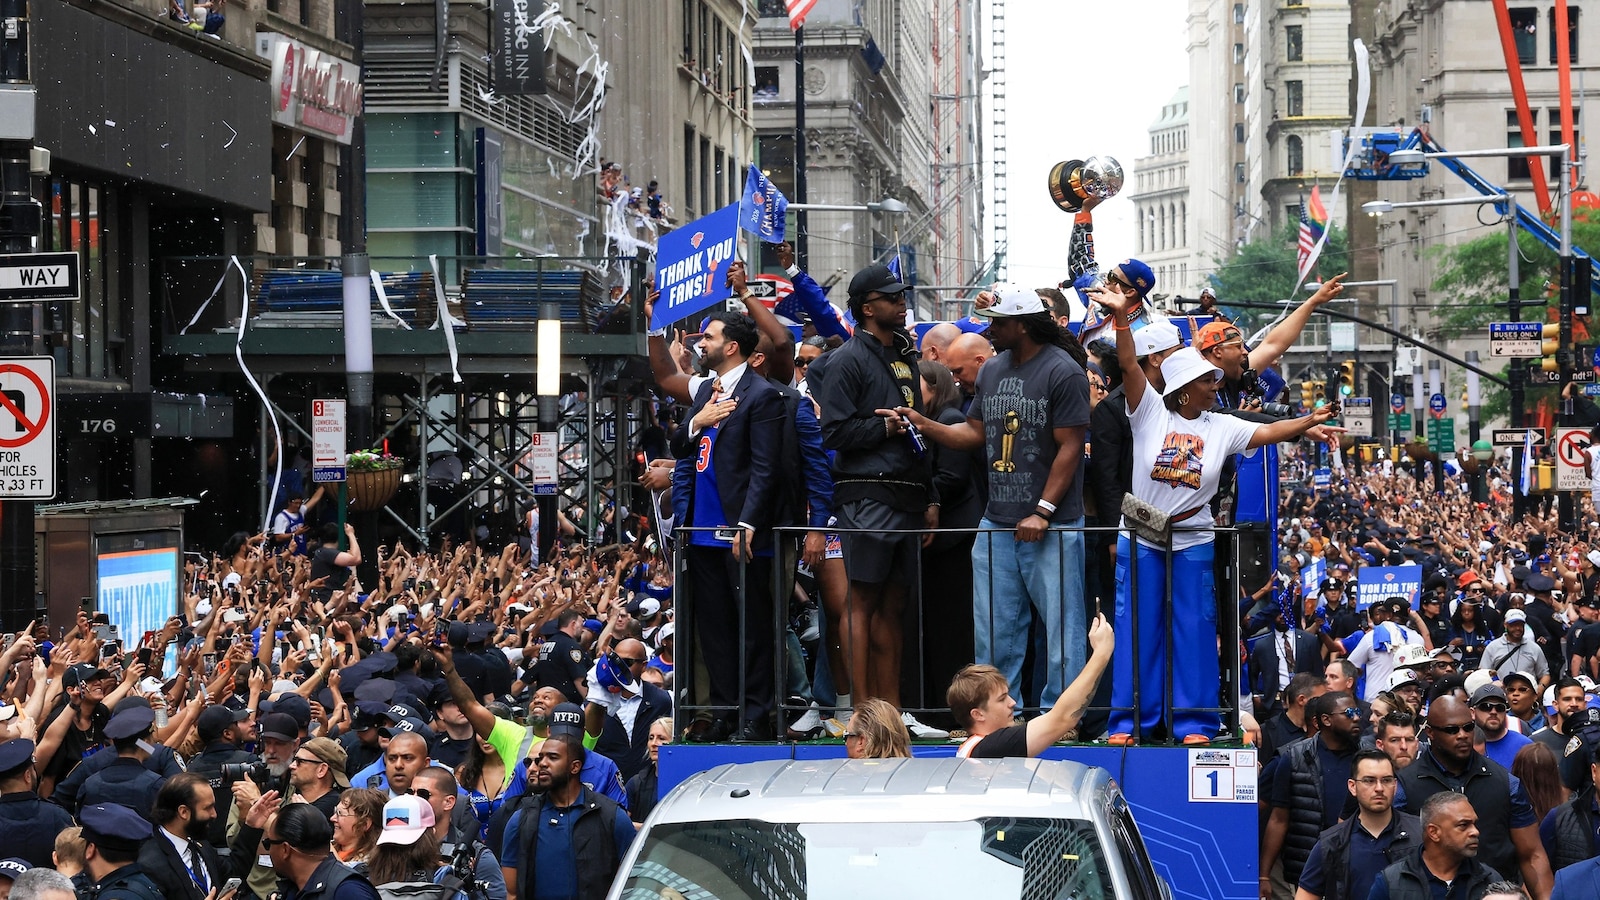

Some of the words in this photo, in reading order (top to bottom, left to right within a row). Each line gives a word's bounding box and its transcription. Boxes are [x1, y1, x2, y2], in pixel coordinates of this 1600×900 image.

[503, 11, 511, 24] BY
[504, 27, 513, 79] MARRIOTT
[515, 54, 530, 79] INN
[659, 250, 704, 290] THANK
[706, 237, 733, 268] YOU
[19, 267, 60, 286] WAY
[668, 272, 708, 309] FANS!
[754, 284, 769, 293] WAY
[1548, 370, 1586, 381] Condt
[1256, 376, 1271, 392] NBA
[315, 402, 322, 415] 3
[81, 418, 116, 433] 176
[534, 434, 540, 445] 3
[1020, 427, 1037, 441] 26
[0, 451, 21, 463] FOR
[696, 436, 712, 472] 3
[30, 479, 44, 490] FT
[1360, 583, 1381, 594] WON
[1382, 582, 1399, 594] FOR
[1401, 581, 1419, 593] THE
[553, 711, 580, 724] NYPD
[1206, 770, 1218, 797] 1
